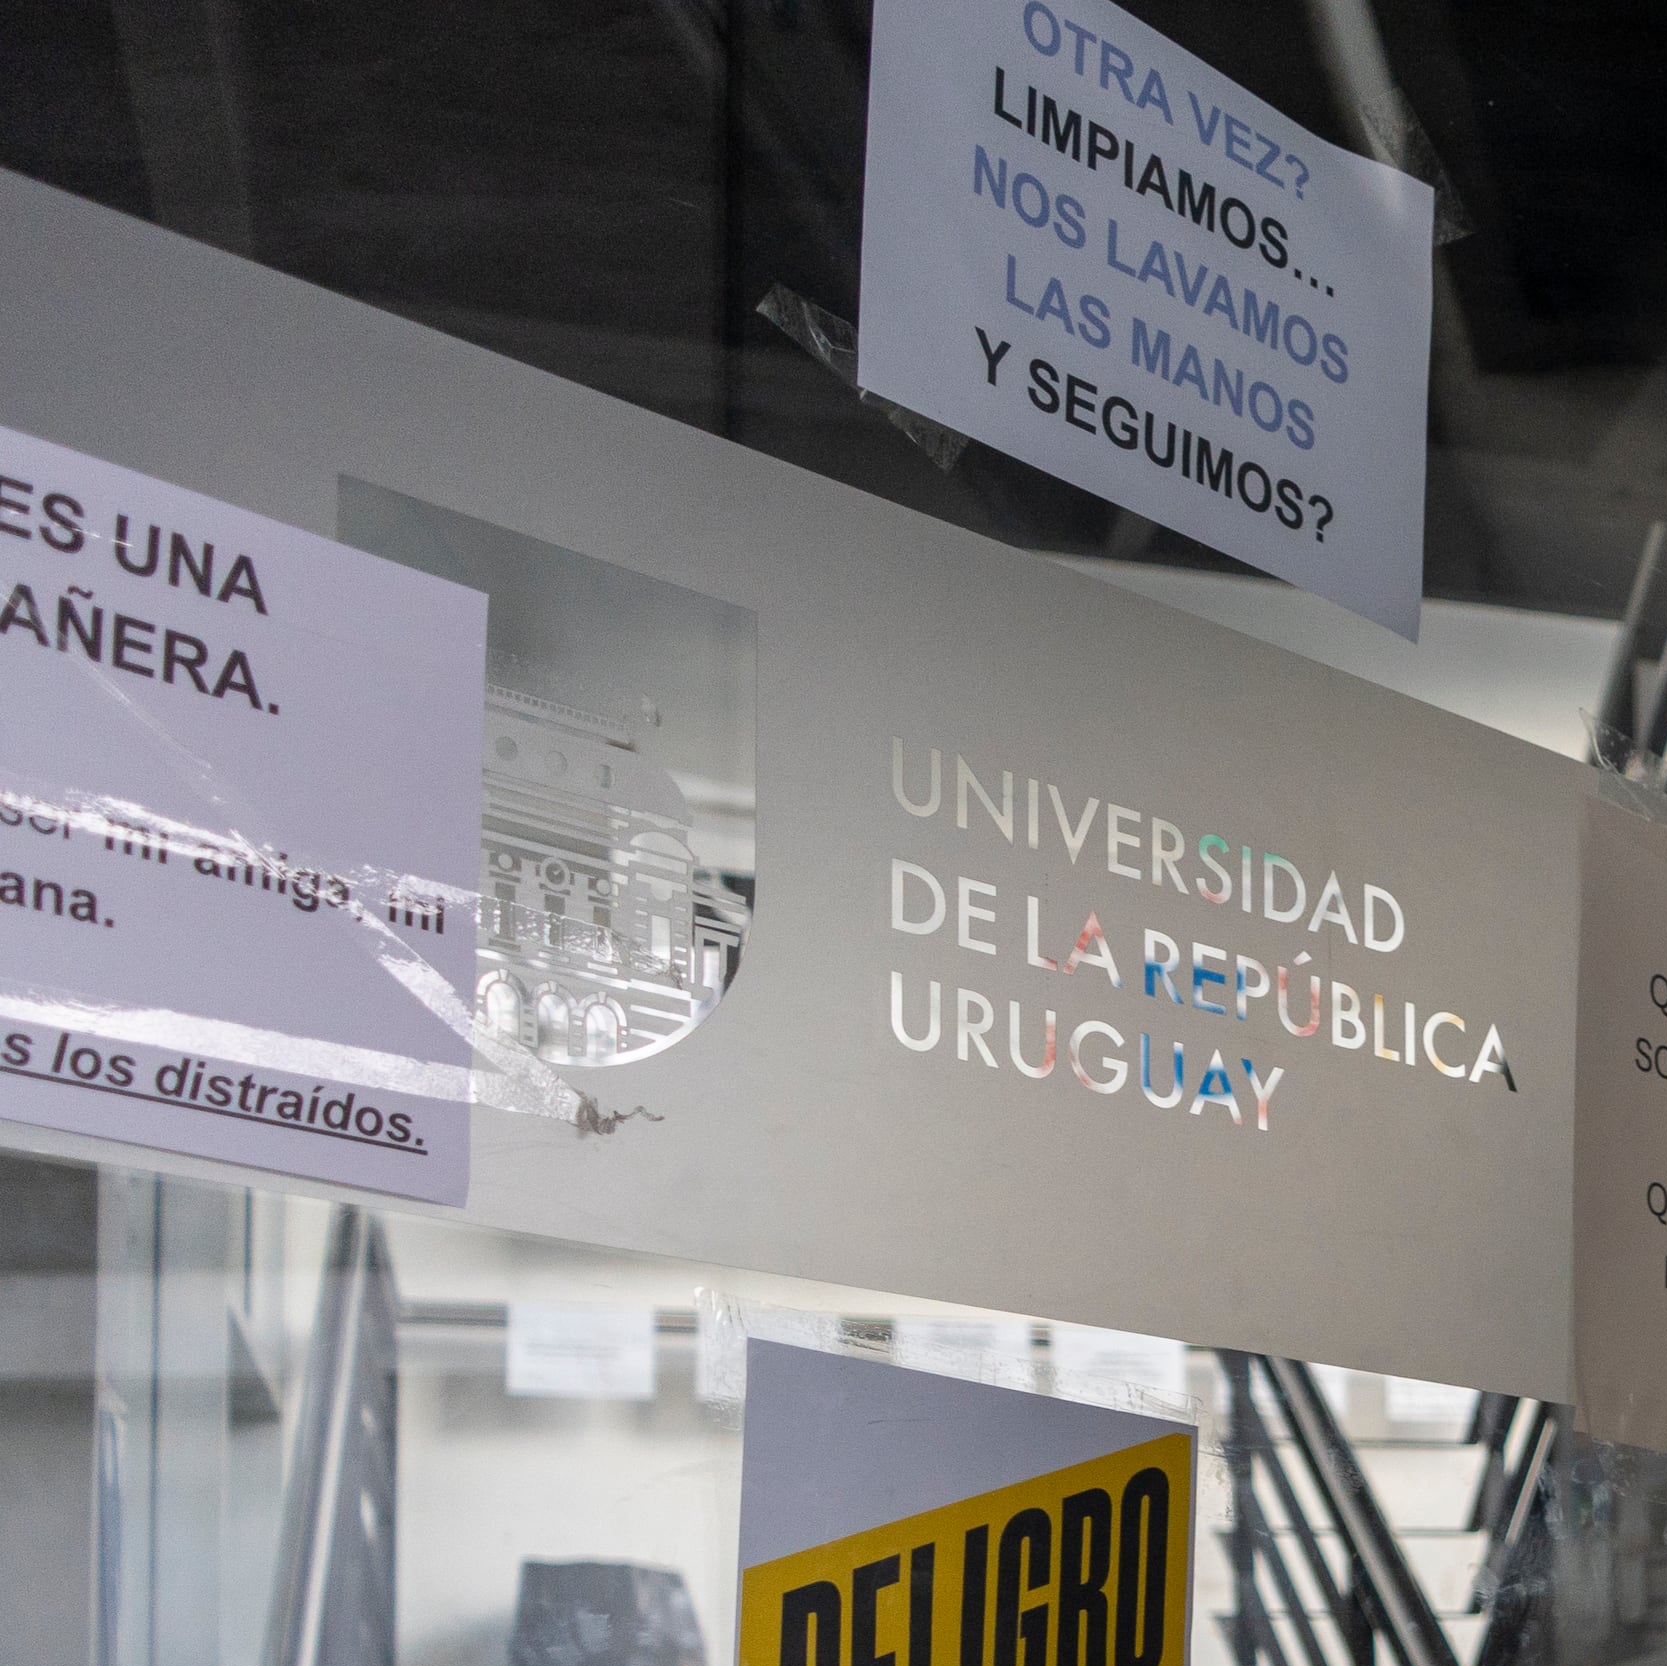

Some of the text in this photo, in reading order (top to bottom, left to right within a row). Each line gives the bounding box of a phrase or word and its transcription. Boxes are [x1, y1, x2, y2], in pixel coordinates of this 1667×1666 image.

[994, 65, 1334, 298] LIMPIAMOS...
[1022, 1, 1311, 200] OTRA VEZ?
[973, 144, 1349, 385] NOS LAVAMOS
[1005, 253, 1315, 451] LAS MANOS
[974, 325, 1334, 544] Y SEGUIMOS?
[113, 513, 269, 616] UNA
[892, 735, 1405, 953] UNIVERSIDAD
[890, 970, 1285, 1131] URUGUAY
[891, 858, 1518, 1093] DE LA REPÚBLICA
[52, 1032, 135, 1086] los
[155, 1058, 424, 1146] distraídos.
